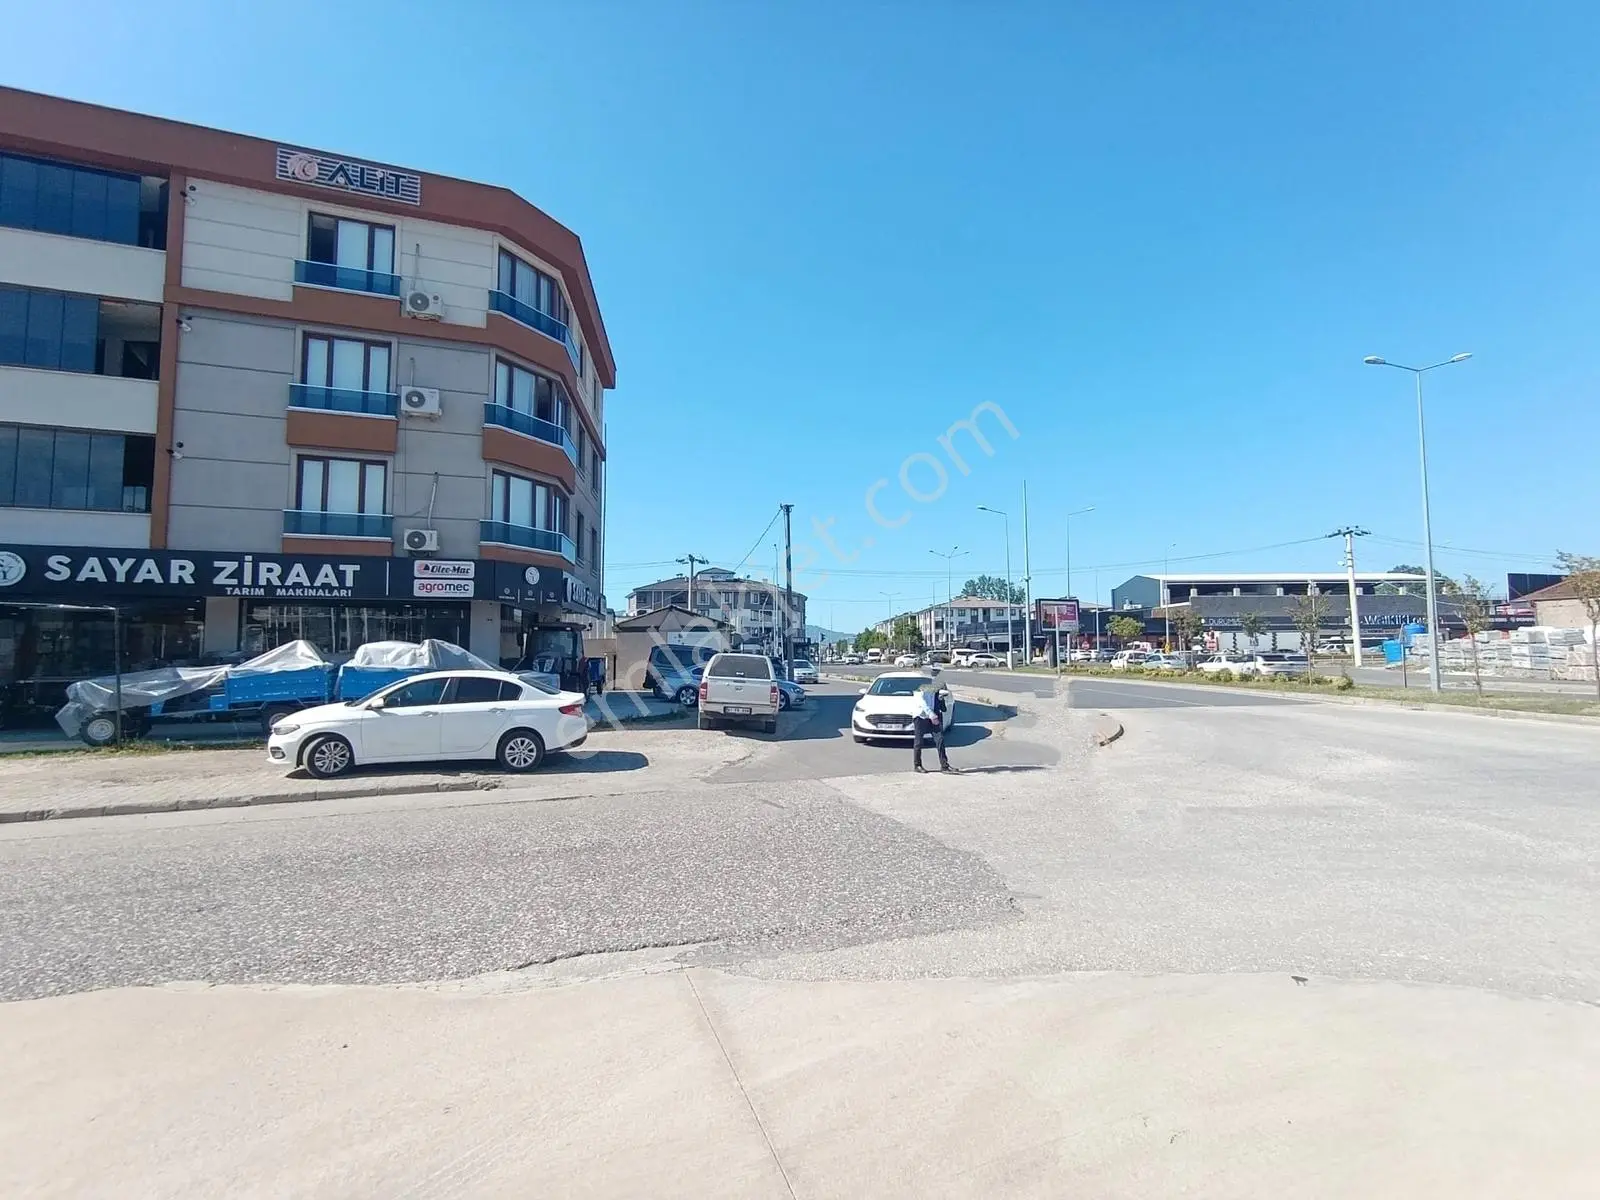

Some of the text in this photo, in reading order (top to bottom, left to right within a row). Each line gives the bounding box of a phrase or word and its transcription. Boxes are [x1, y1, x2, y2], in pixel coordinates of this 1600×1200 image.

[44, 555, 196, 584] SAYAR
[213, 555, 361, 587] ZİRAAT
[225, 587, 265, 596] TARIM
[418, 583, 470, 594] agromec
